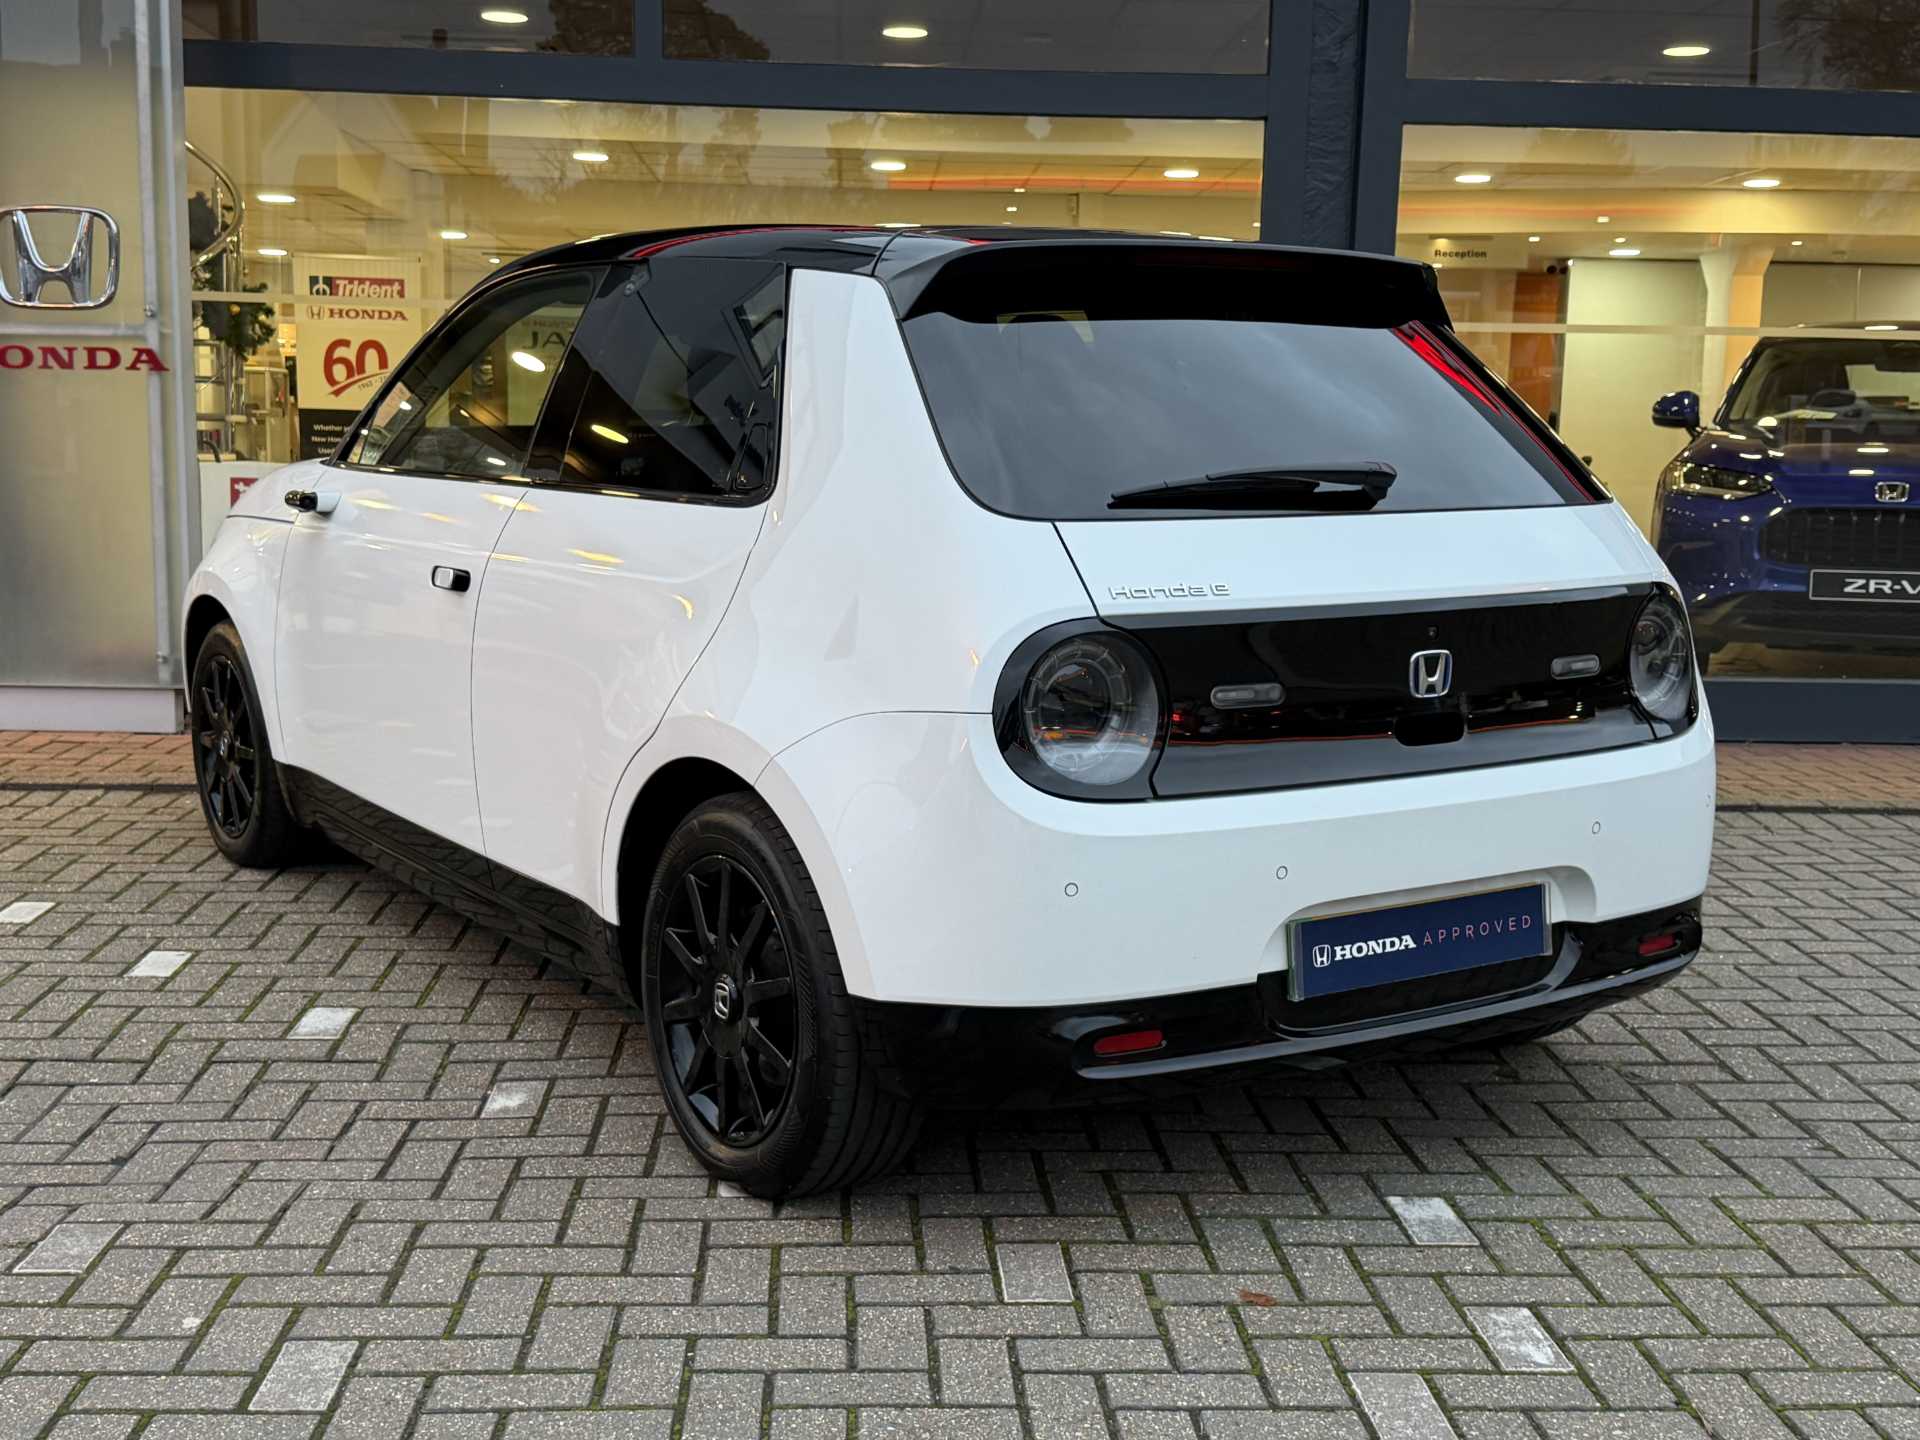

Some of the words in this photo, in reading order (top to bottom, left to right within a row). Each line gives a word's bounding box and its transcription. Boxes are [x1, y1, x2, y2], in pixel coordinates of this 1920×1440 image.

[1434, 249, 1487, 260] Reception
[335, 279, 402, 298] Trident
[328, 308, 408, 321] HONDA
[521, 331, 571, 349] JA
[323, 338, 389, 388] 60
[1107, 583, 1208, 600] Honda
[1843, 578, 1920, 594] ZR-V
[1333, 934, 1417, 961] HONDA
[1423, 914, 1532, 946] APPROVED
